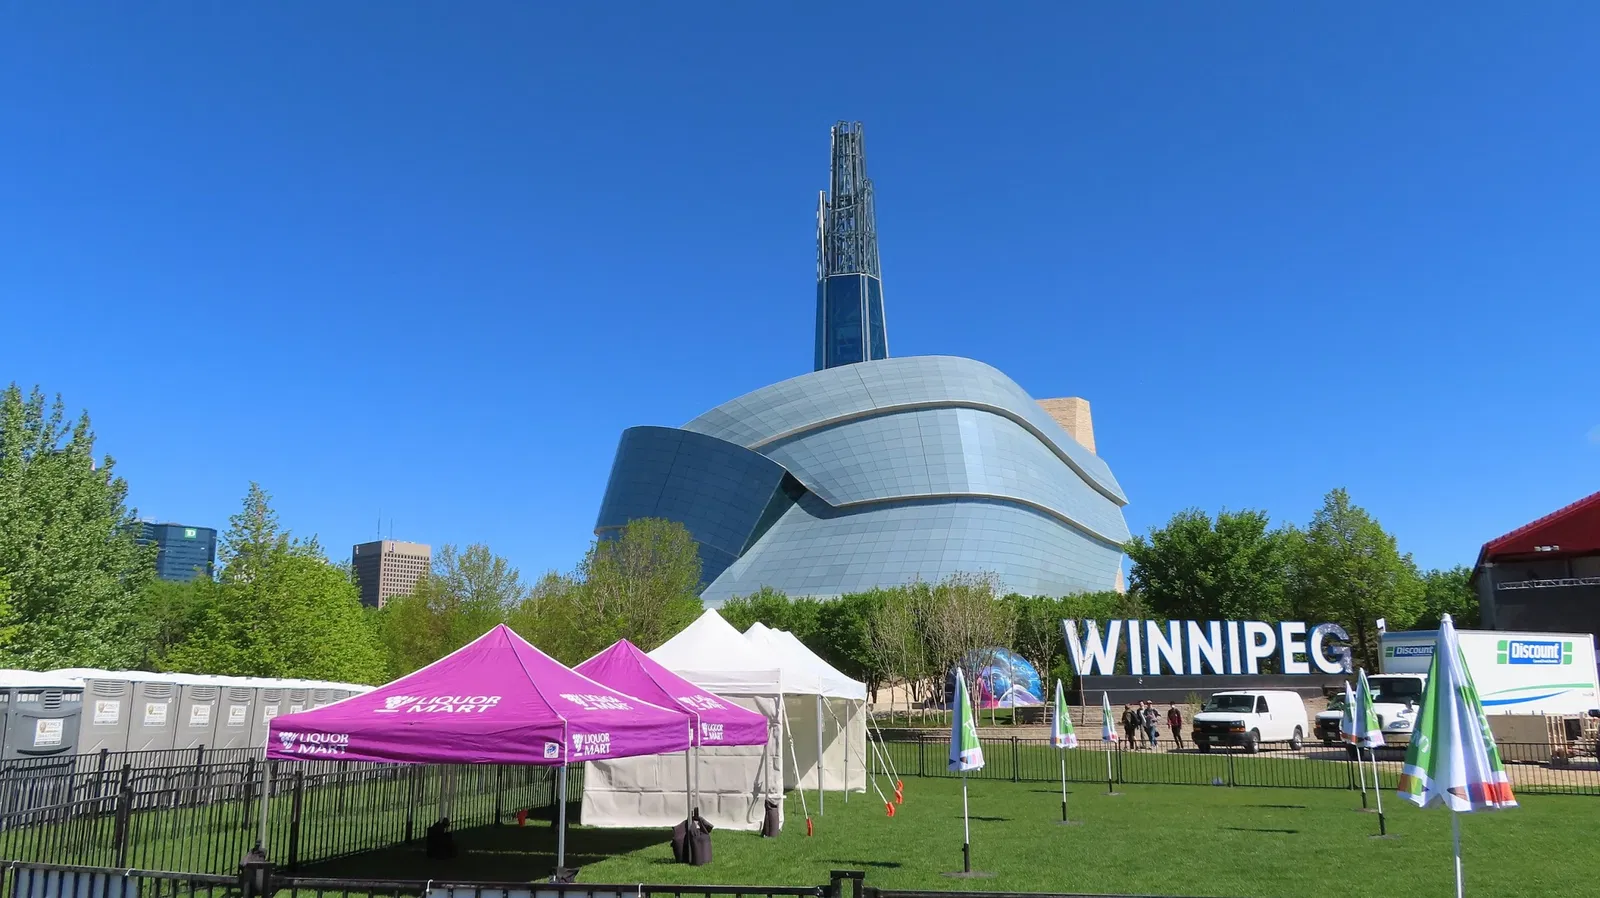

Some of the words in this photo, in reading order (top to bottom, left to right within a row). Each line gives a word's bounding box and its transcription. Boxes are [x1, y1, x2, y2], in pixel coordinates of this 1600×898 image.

[1062, 619, 1353, 675] WINNIPEG
[1397, 646, 1434, 654] Discount
[1511, 642, 1559, 658] Discount
[416, 695, 502, 705] LIQUOR
[406, 704, 497, 713] MART
[299, 733, 349, 744] LIQUOR
[584, 732, 610, 745] LIQUOR
[297, 743, 349, 754] MART
[584, 743, 611, 755] MART
